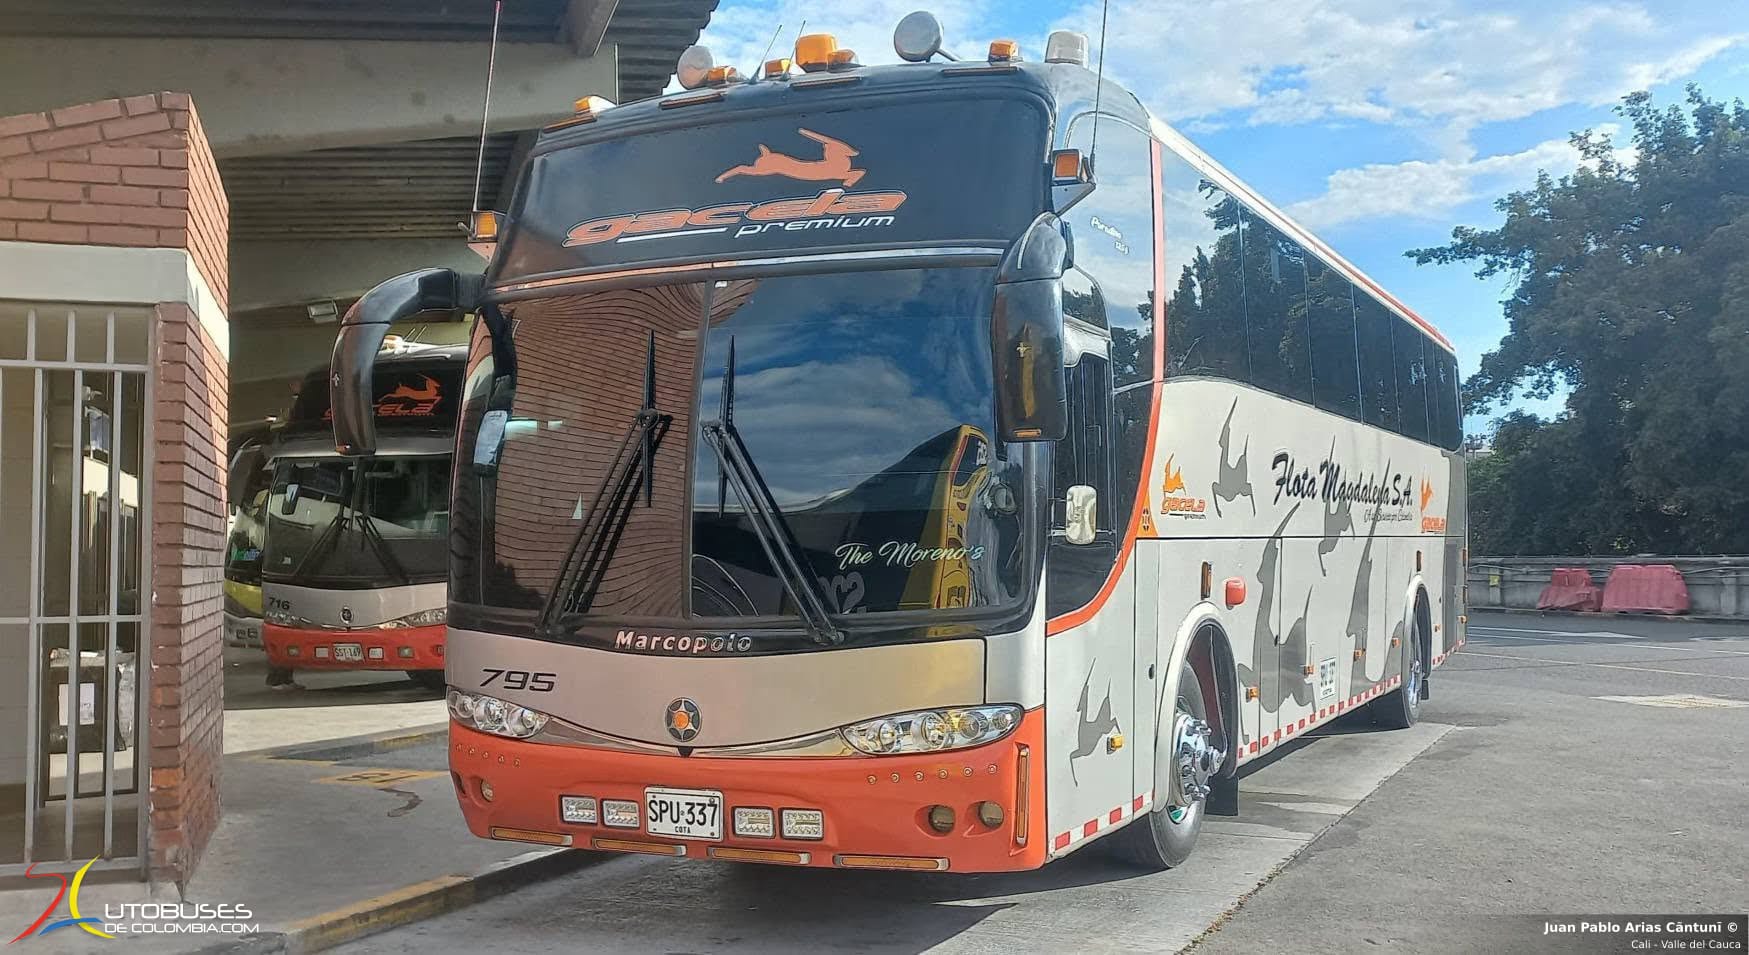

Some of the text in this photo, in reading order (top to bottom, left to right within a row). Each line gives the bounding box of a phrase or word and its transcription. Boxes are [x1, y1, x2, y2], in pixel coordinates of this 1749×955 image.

[561, 188, 907, 248] gacela
[735, 215, 895, 238] premium
[1272, 452, 1318, 505] Flota
[835, 541, 986, 570] The Moreno's
[269, 597, 290, 610] 716
[614, 630, 752, 653] Marcopolo
[480, 668, 557, 692] 795
[674, 825, 692, 834] COTA
